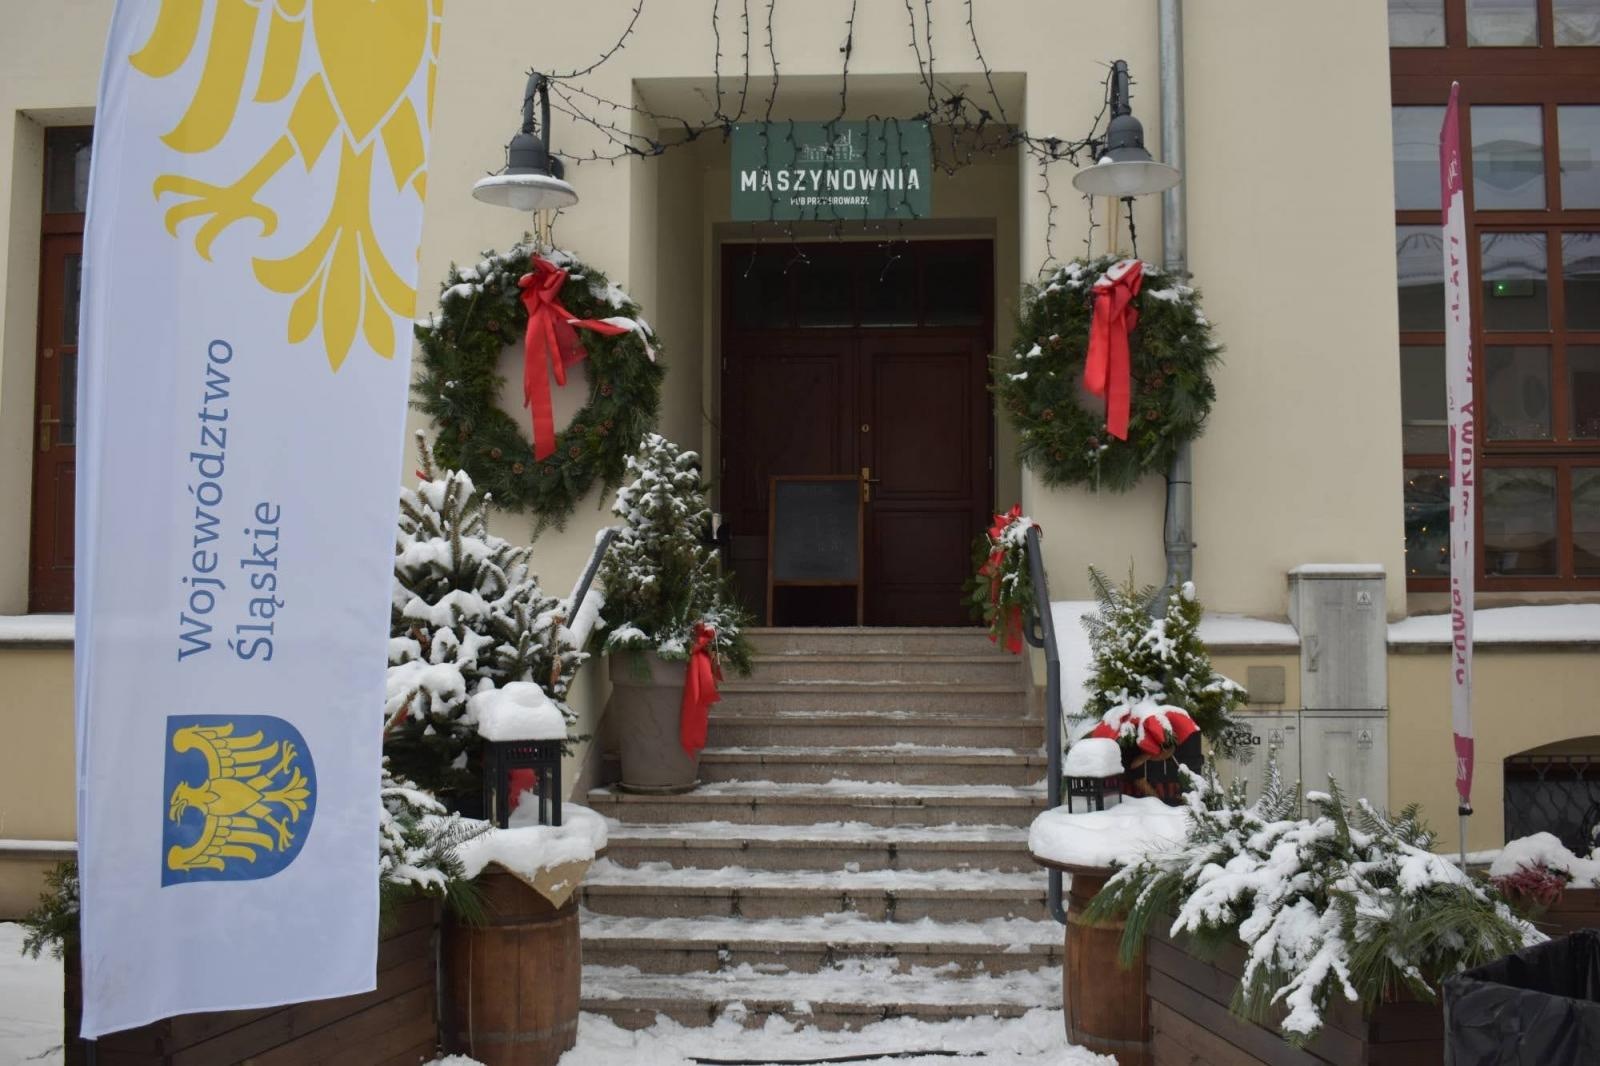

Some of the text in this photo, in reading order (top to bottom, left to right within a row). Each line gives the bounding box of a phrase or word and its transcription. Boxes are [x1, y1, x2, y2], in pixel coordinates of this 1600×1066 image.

[741, 168, 920, 192] MASZYNOWNIA
[177, 339, 233, 662] Województwo
[228, 502, 284, 662] Śląskie
